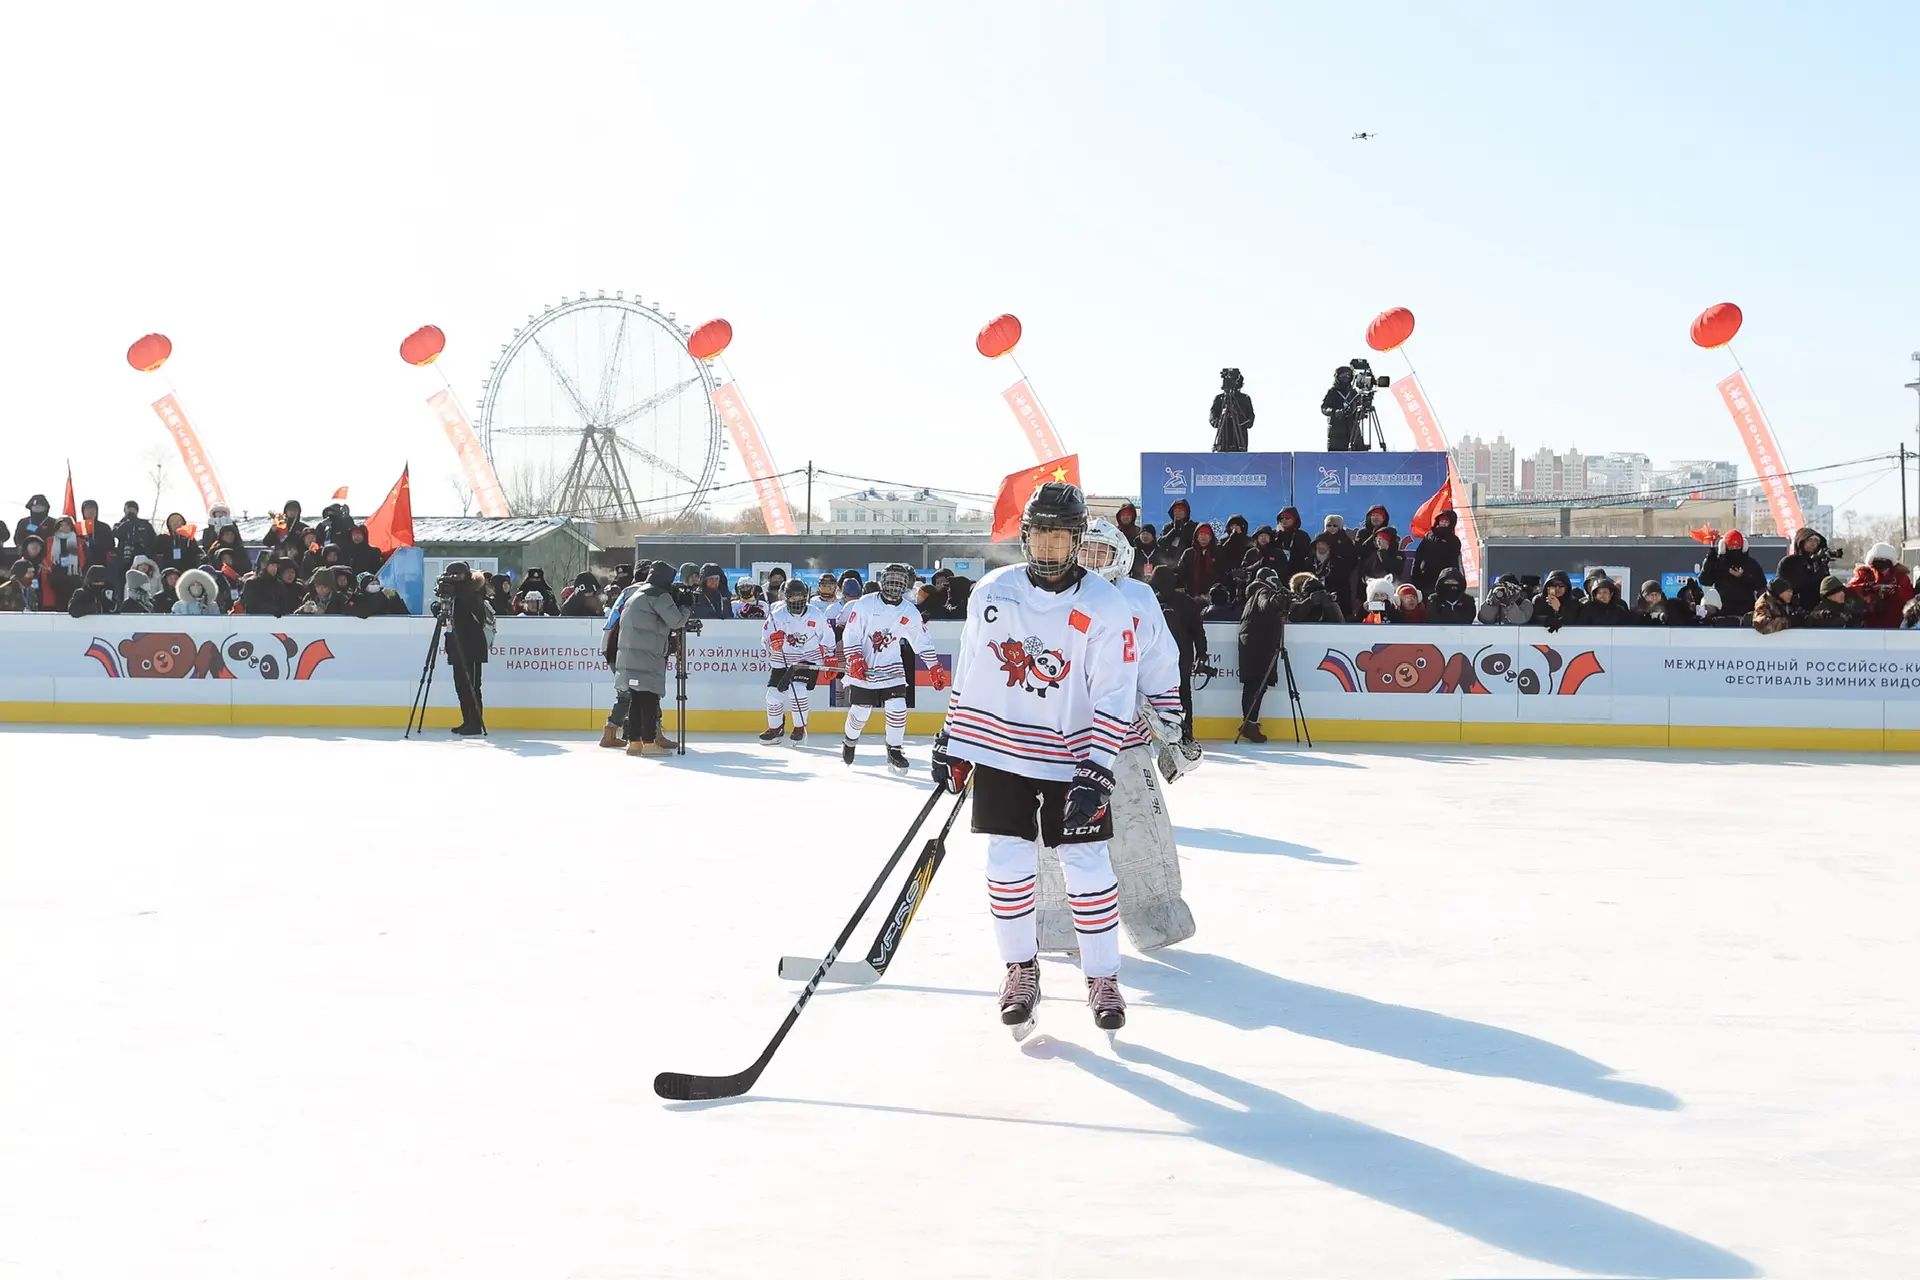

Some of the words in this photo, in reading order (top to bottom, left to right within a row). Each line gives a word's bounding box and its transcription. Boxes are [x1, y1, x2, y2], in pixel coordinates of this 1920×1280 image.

[984, 605, 999, 623] C
[509, 646, 605, 657] ПРАВИТЕЛЬСТВ
[506, 660, 574, 671] НАРОДНОЕ
[1664, 658, 1798, 672] МЕЖДУНАРОДНЫЙ
[1725, 675, 1812, 686] ФЕСТИВАЛЬ
[1816, 676, 1876, 687] ЗИМНИХ
[1063, 825, 1101, 836] CCM
